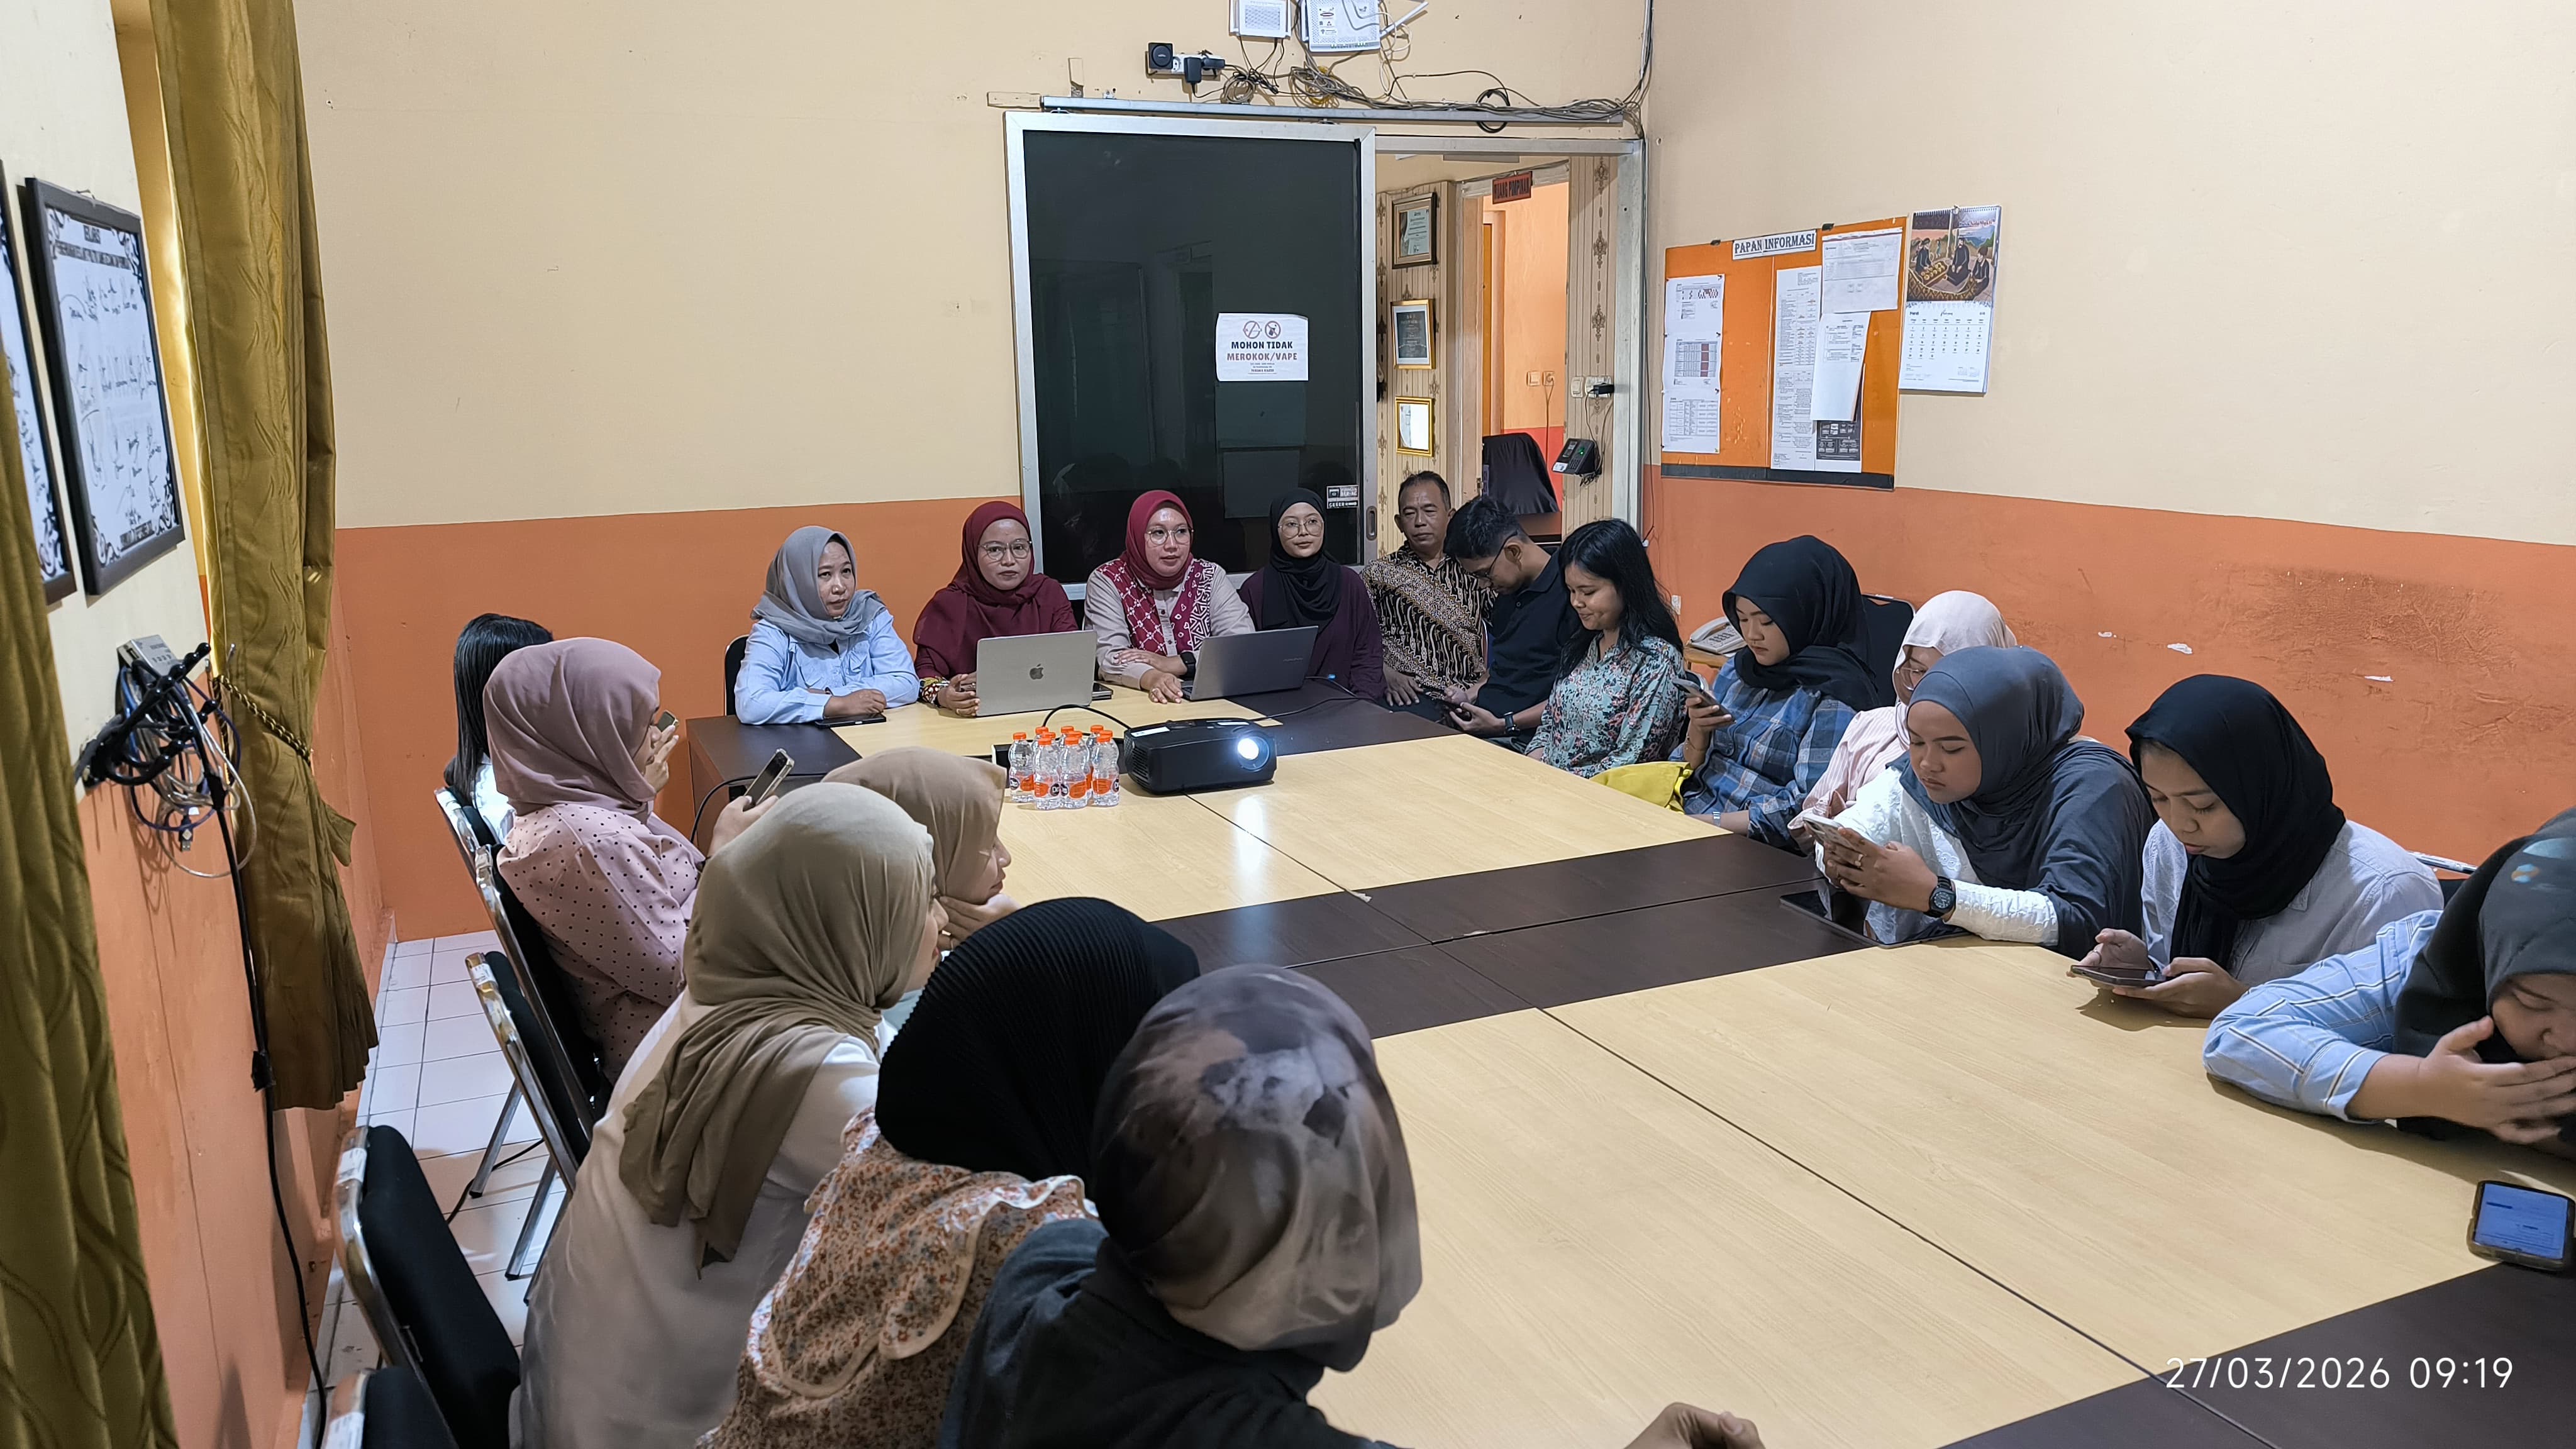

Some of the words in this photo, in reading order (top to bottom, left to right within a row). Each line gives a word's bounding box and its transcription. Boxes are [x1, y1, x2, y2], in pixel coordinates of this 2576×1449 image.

[1735, 240, 1762, 254] PAPAN
[1765, 233, 1815, 250] INFORMASI
[1227, 352, 1297, 361] MEROKOK/VAPE
